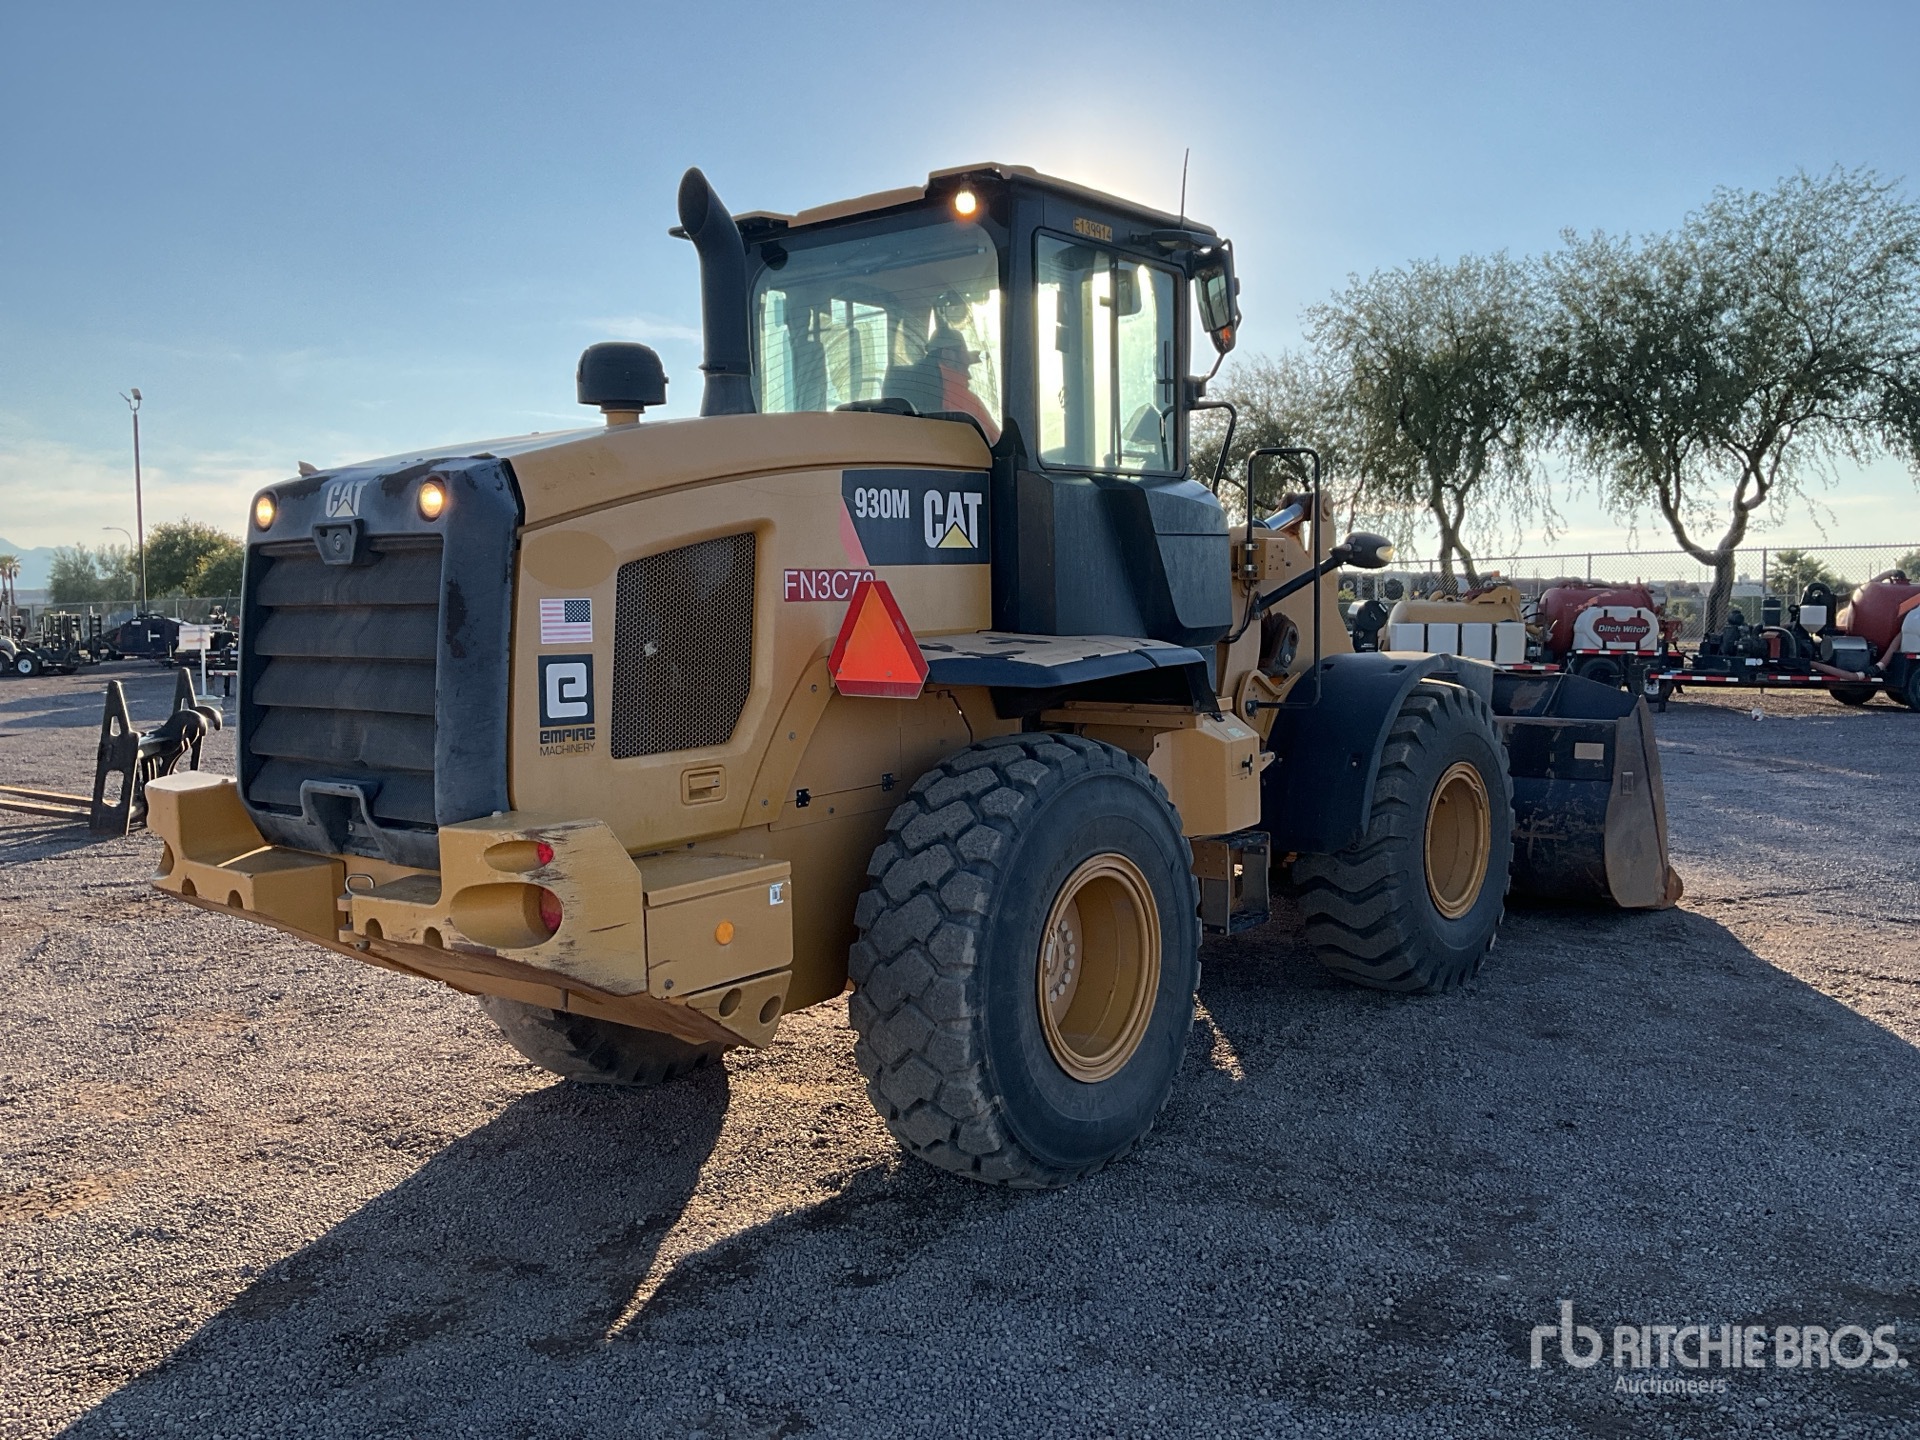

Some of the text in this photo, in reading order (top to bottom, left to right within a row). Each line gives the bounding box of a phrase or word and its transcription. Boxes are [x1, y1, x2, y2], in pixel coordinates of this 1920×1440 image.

[326, 480, 369, 517] CAT
[855, 488, 982, 548] 930M CAT
[1598, 625, 1621, 633] Ditch
[540, 743, 595, 756] MACHINERY
